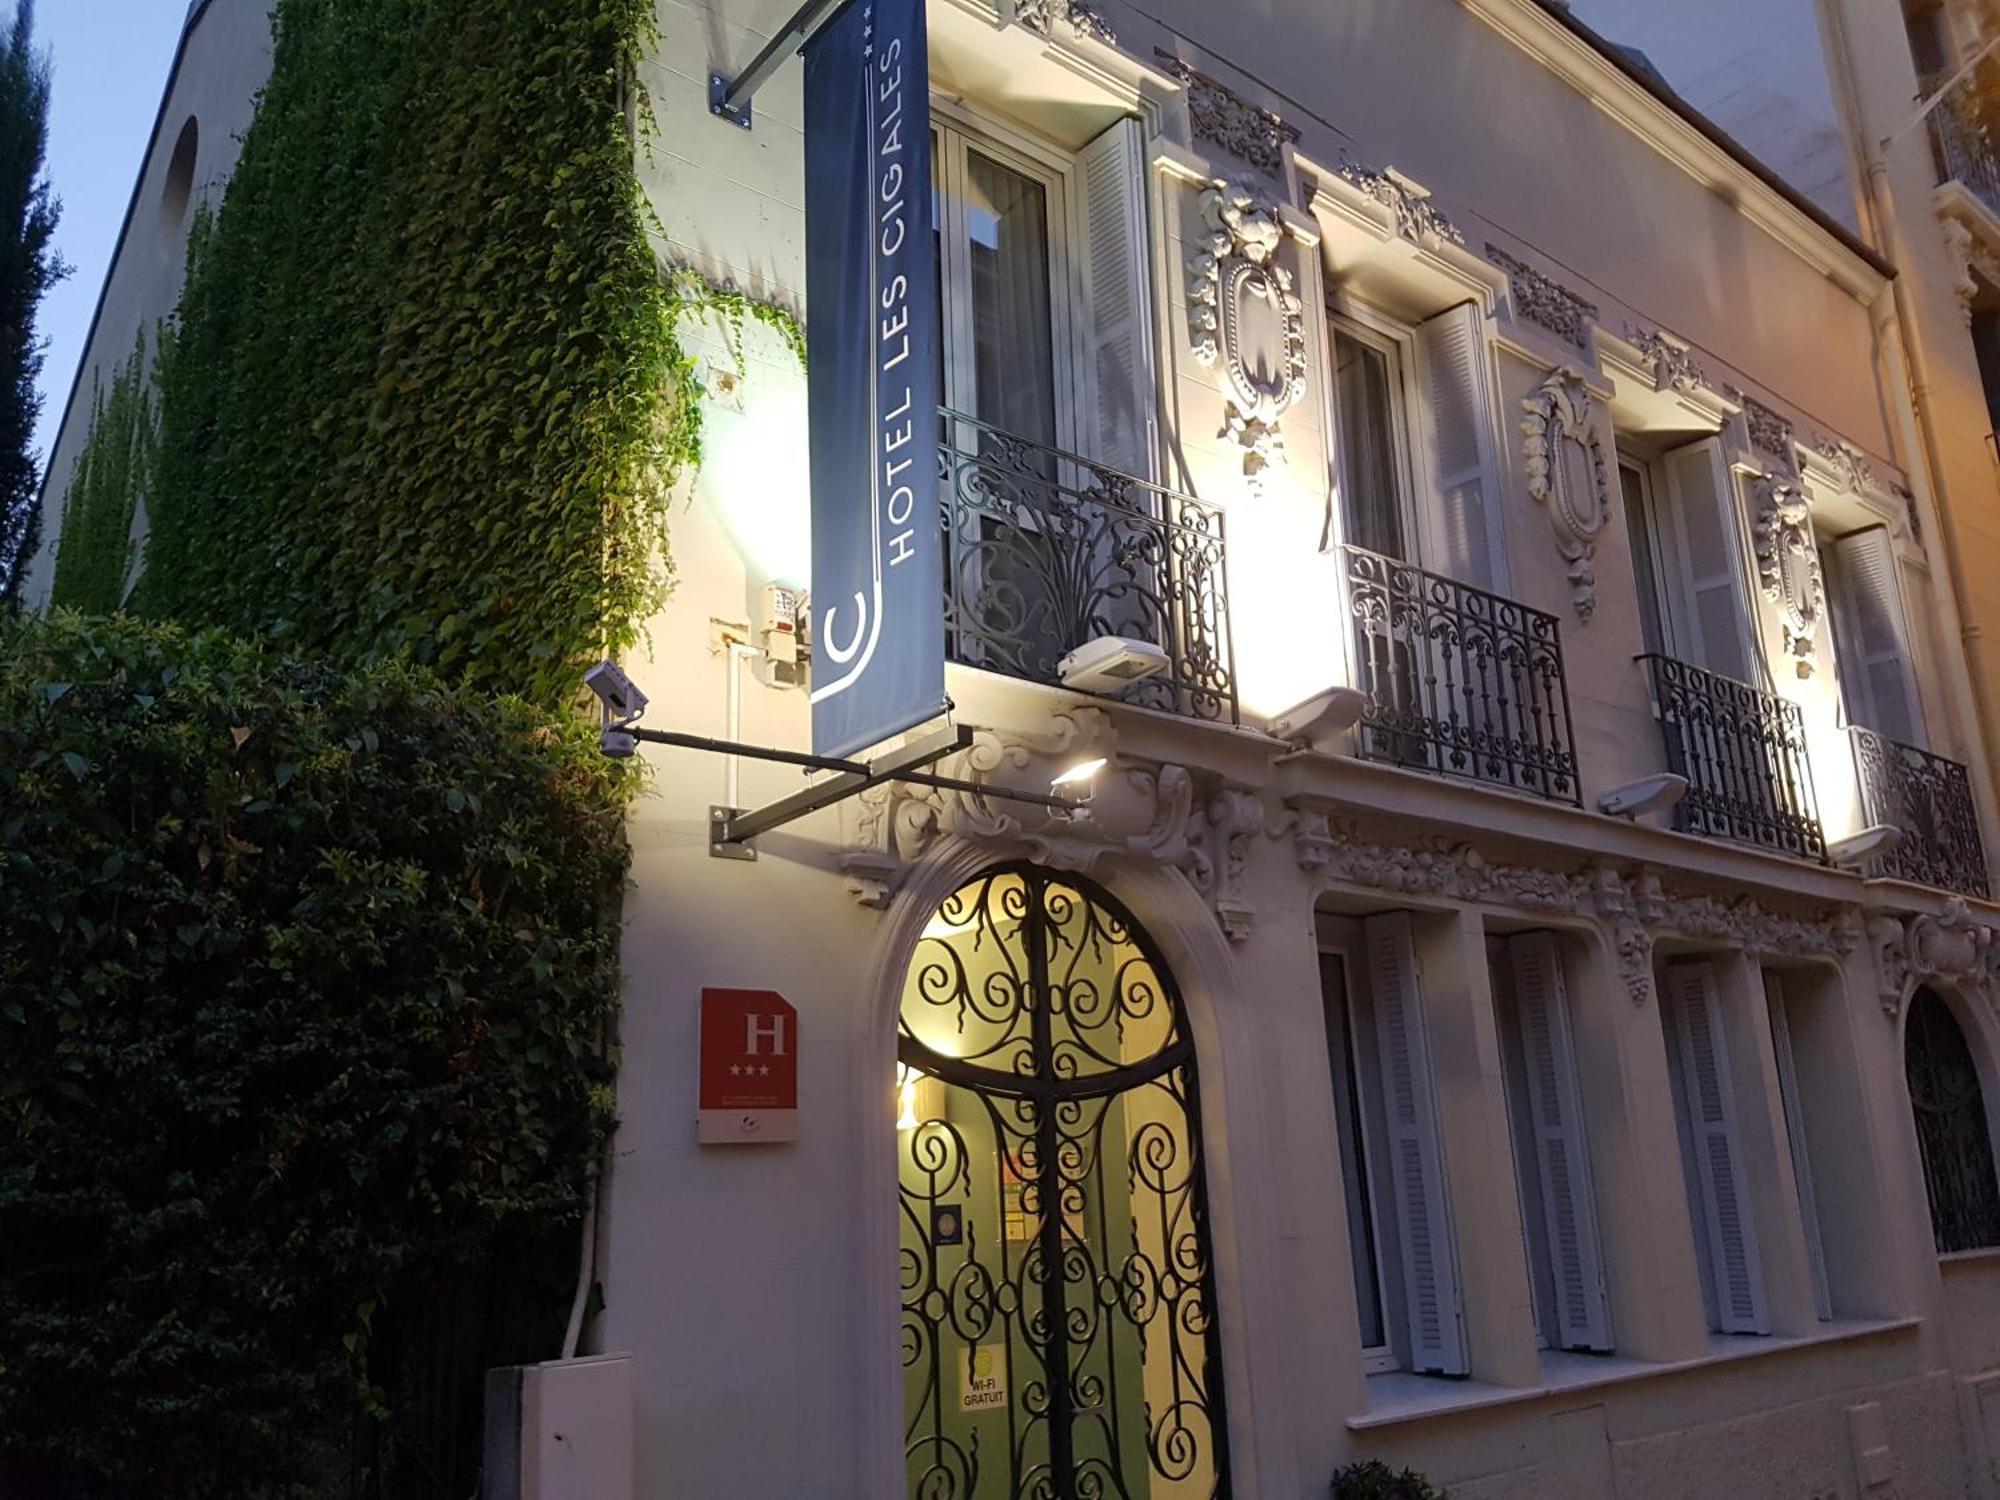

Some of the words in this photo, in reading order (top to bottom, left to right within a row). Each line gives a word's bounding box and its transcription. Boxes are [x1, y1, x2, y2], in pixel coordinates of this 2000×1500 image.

[880, 38, 905, 257] CIGALES
[882, 274, 909, 371] LES
[884, 386, 915, 566] HOTEL
[744, 1013, 787, 1055] H
[964, 1391, 1004, 1406] GRATUIT
[972, 1378, 995, 1391] WI-FI
